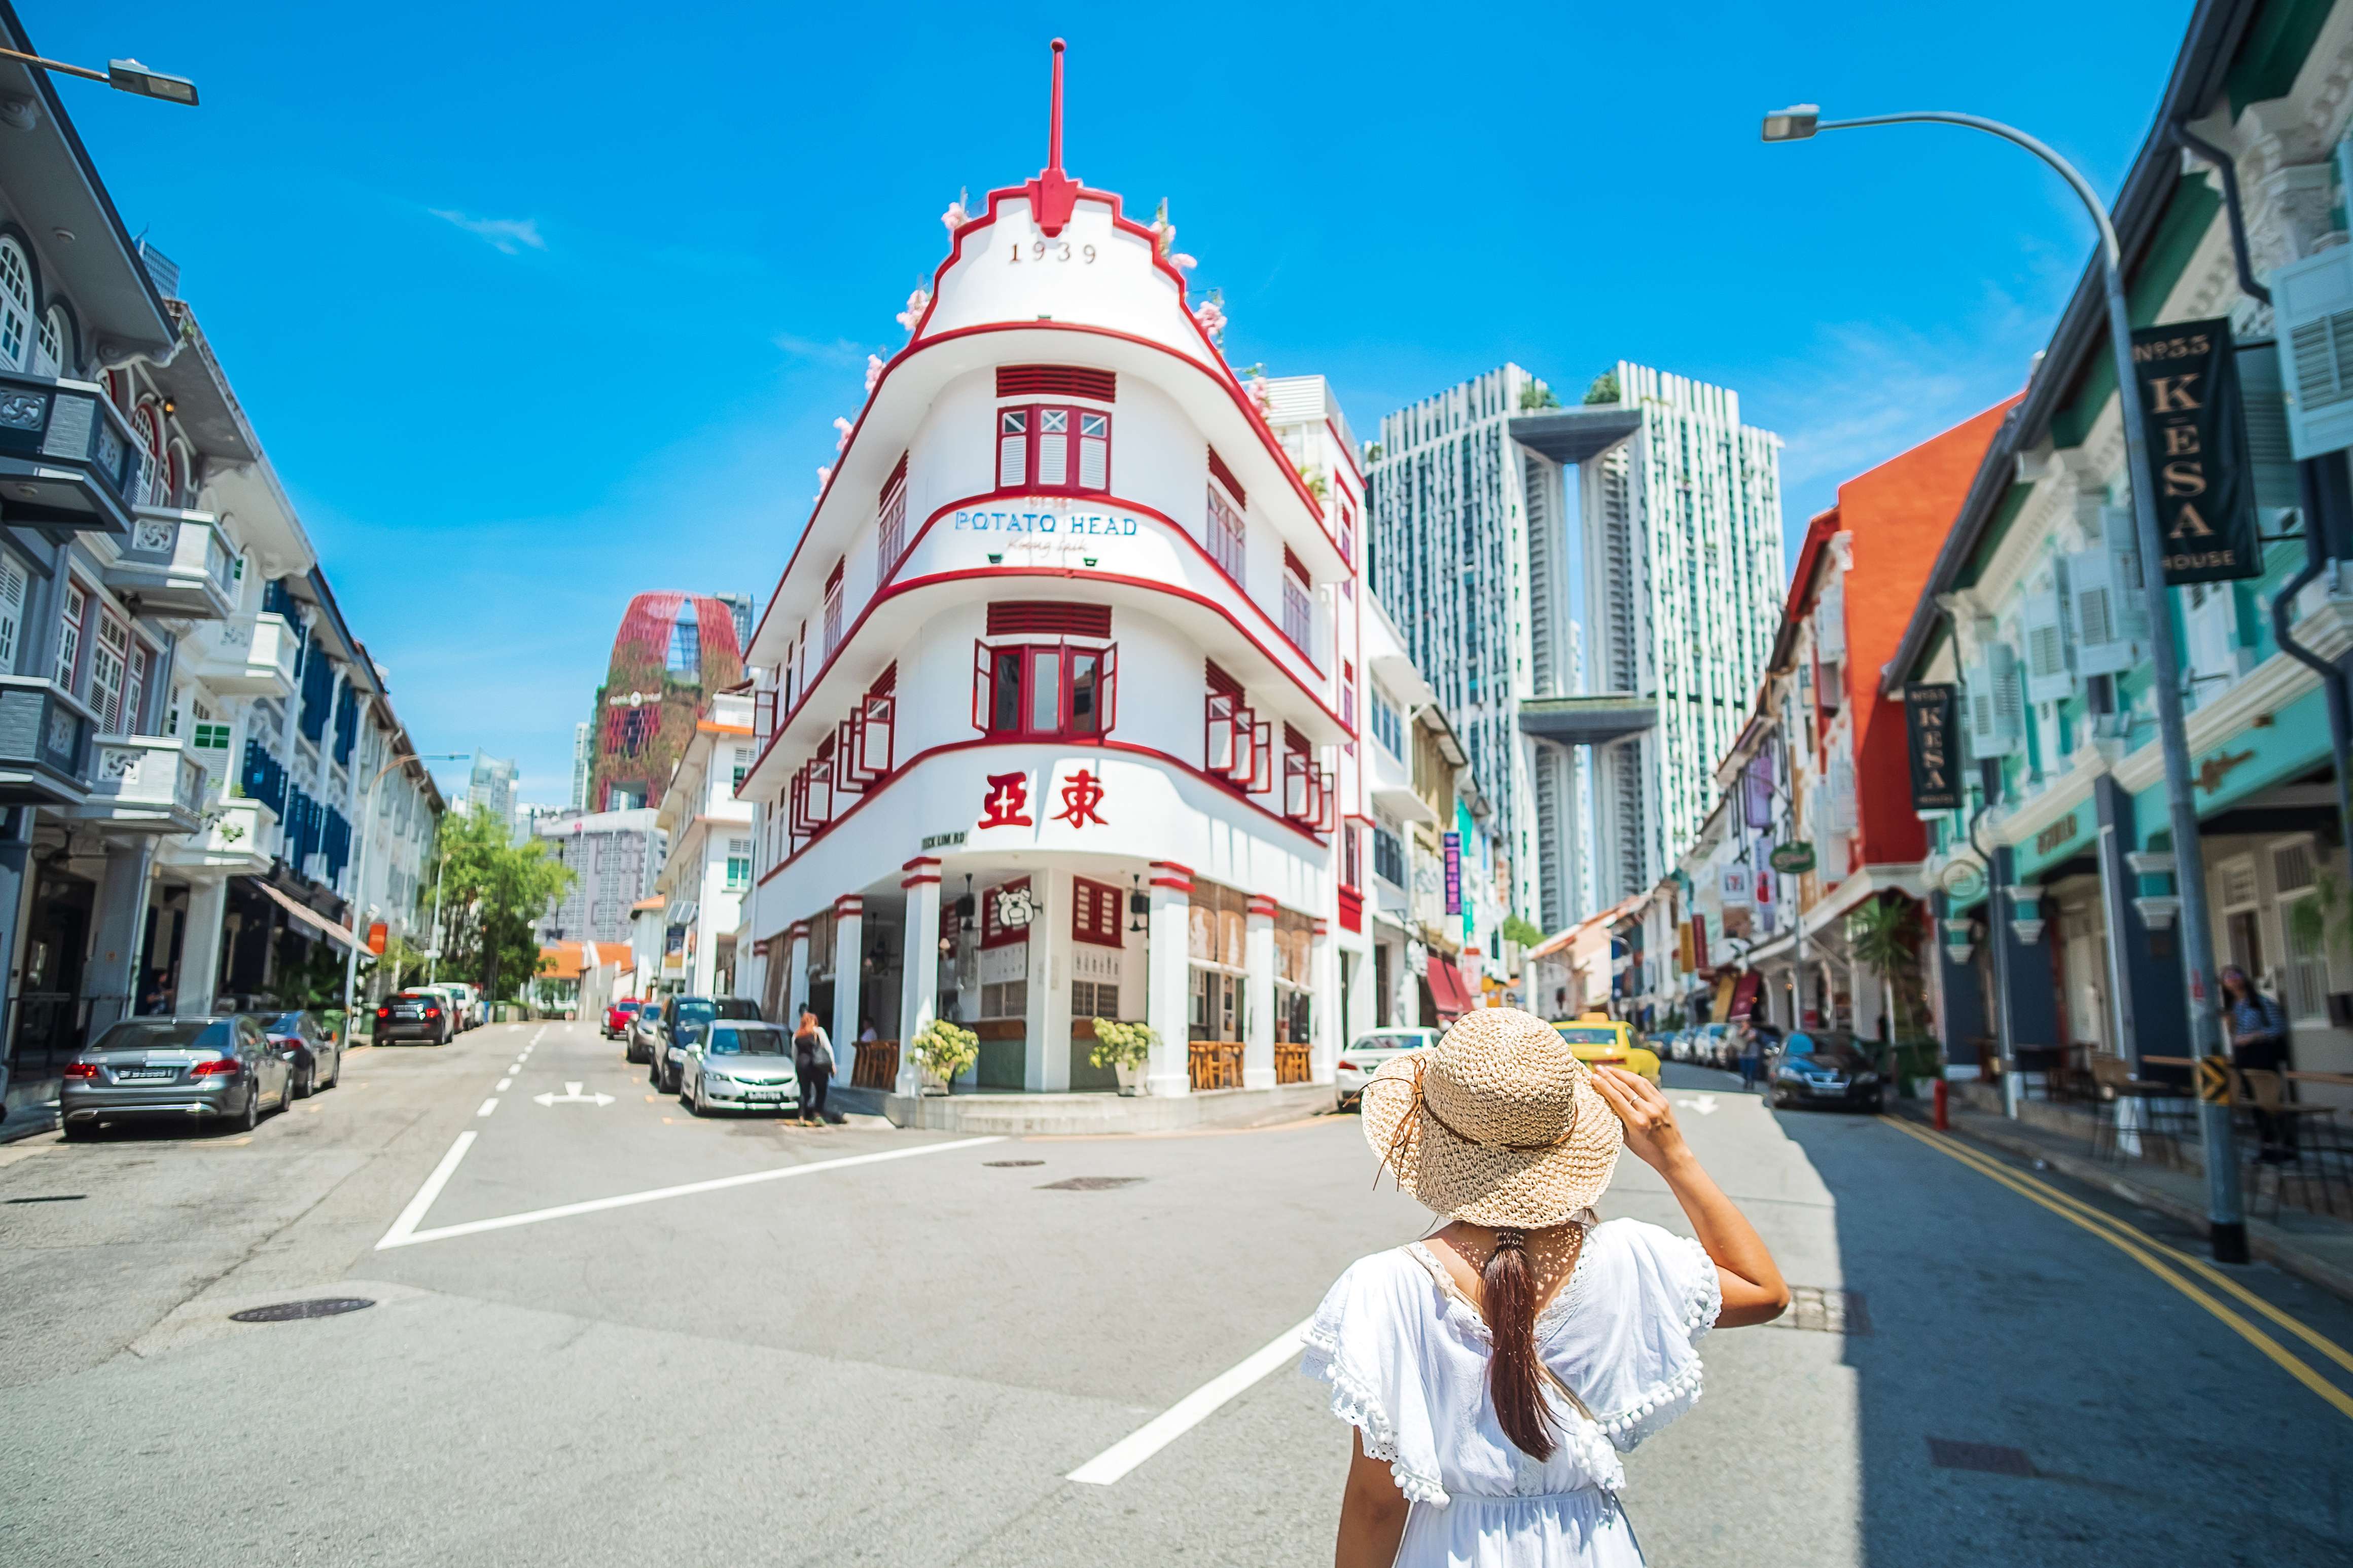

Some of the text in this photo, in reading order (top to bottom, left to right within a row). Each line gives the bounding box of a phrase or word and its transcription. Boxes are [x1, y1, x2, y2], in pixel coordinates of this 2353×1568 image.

[1010, 241, 1095, 264] 1939
[955, 512, 1136, 535] POTATO HEAD
